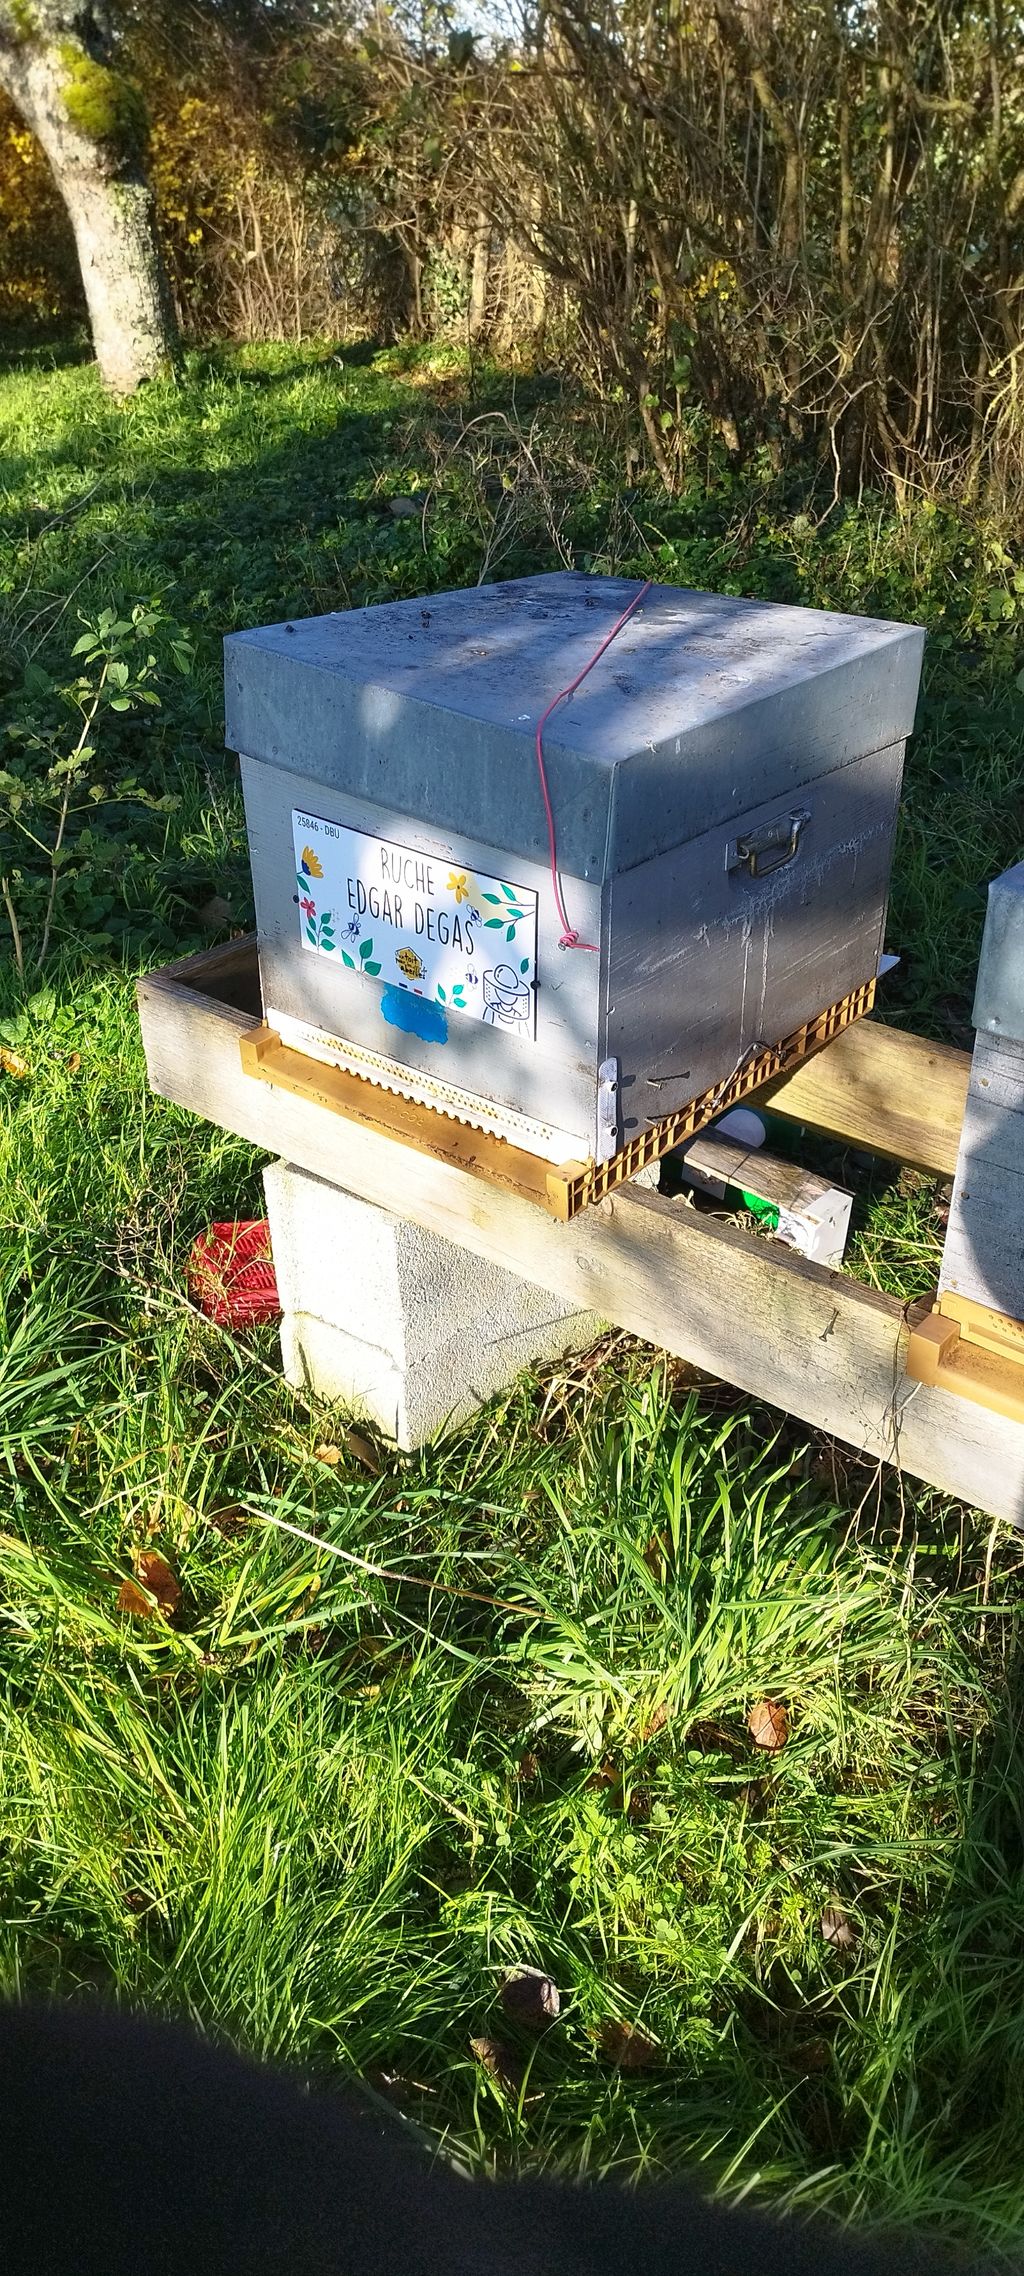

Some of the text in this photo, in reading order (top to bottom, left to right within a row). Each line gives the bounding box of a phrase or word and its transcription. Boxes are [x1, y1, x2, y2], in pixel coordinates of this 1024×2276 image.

[297, 815, 319, 832] 25846
[324, 825, 340, 839] DBU
[381, 847, 435, 896] RUCHE
[347, 878, 474, 956] EDGAR DEGAS
